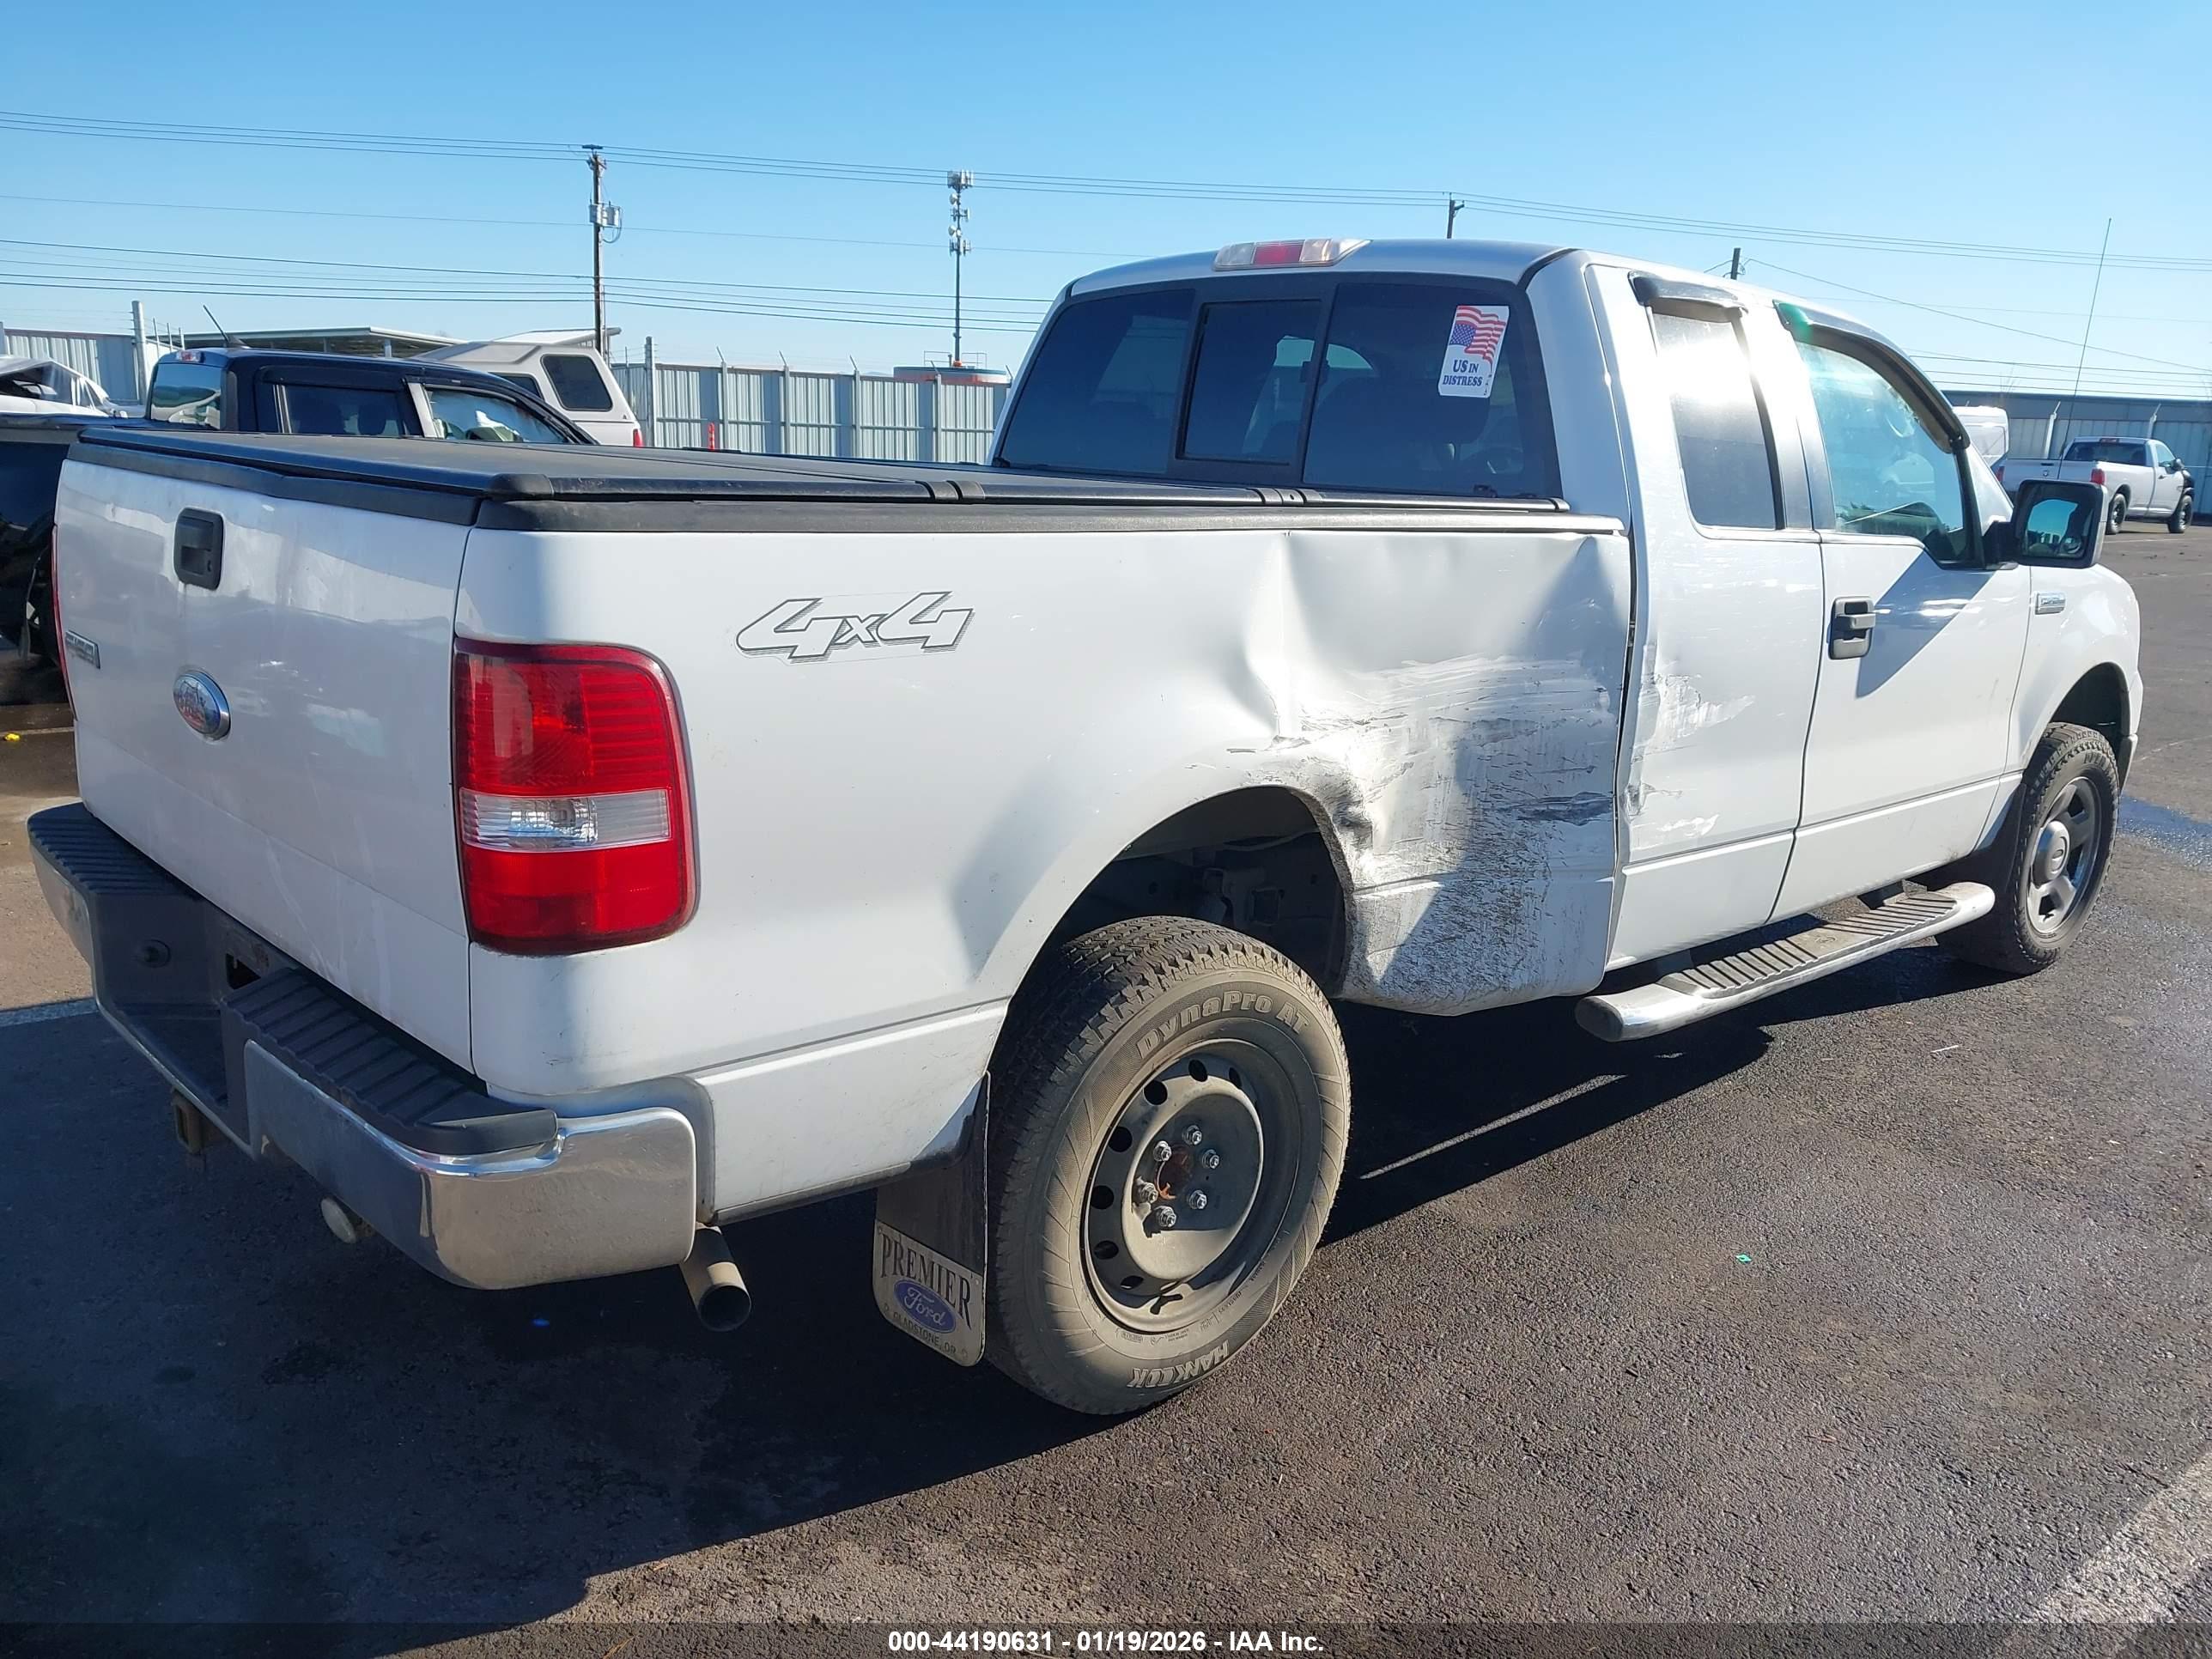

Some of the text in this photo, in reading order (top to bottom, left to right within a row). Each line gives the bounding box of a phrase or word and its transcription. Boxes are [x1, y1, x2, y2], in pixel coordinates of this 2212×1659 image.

[1443, 375, 1483, 386] DISTRESS
[1453, 359, 1479, 374] US IN
[736, 591, 975, 664] 4x4
[1276, 1000, 1310, 1035] AT
[879, 1233, 972, 1330] PREMIER
[904, 1286, 945, 1326] Ford
